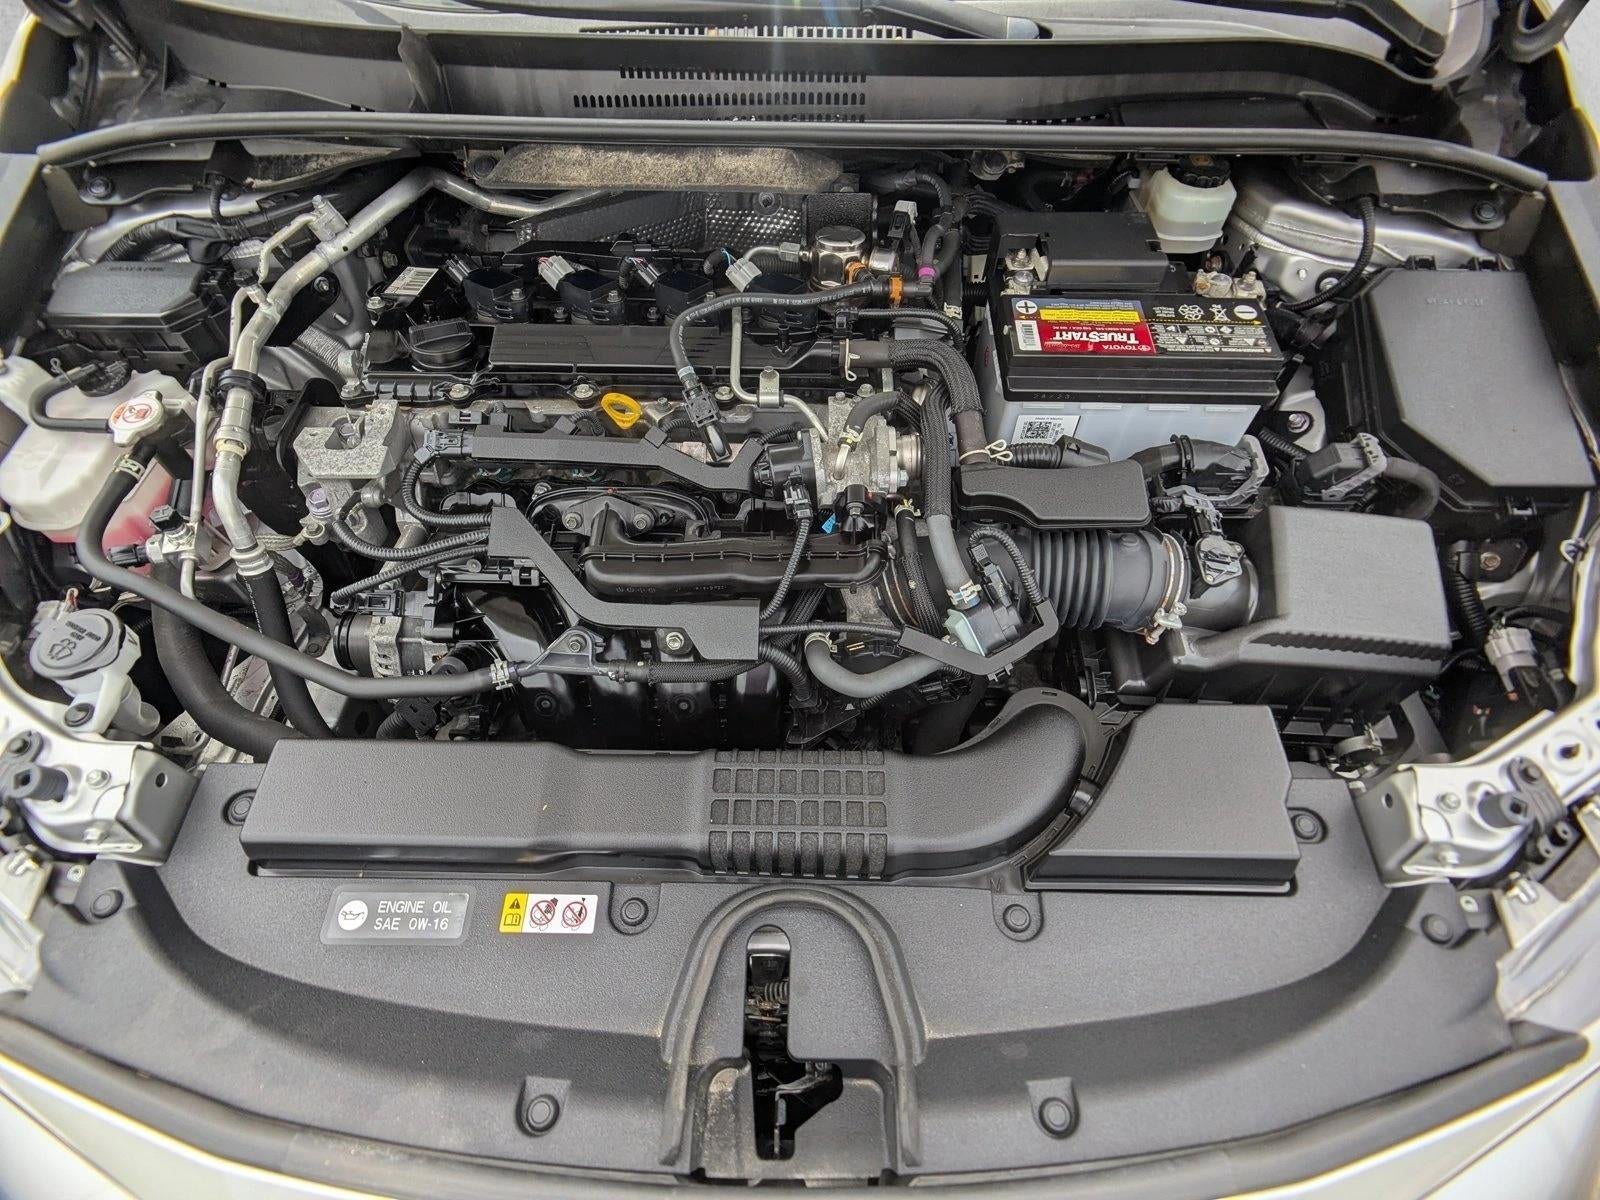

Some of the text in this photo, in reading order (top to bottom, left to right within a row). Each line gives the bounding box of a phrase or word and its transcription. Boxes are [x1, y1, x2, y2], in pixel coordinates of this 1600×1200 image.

[1051, 330, 1139, 345] TRUESTART
[377, 900, 452, 914] ENGINE OIL
[373, 917, 401, 931] SAE
